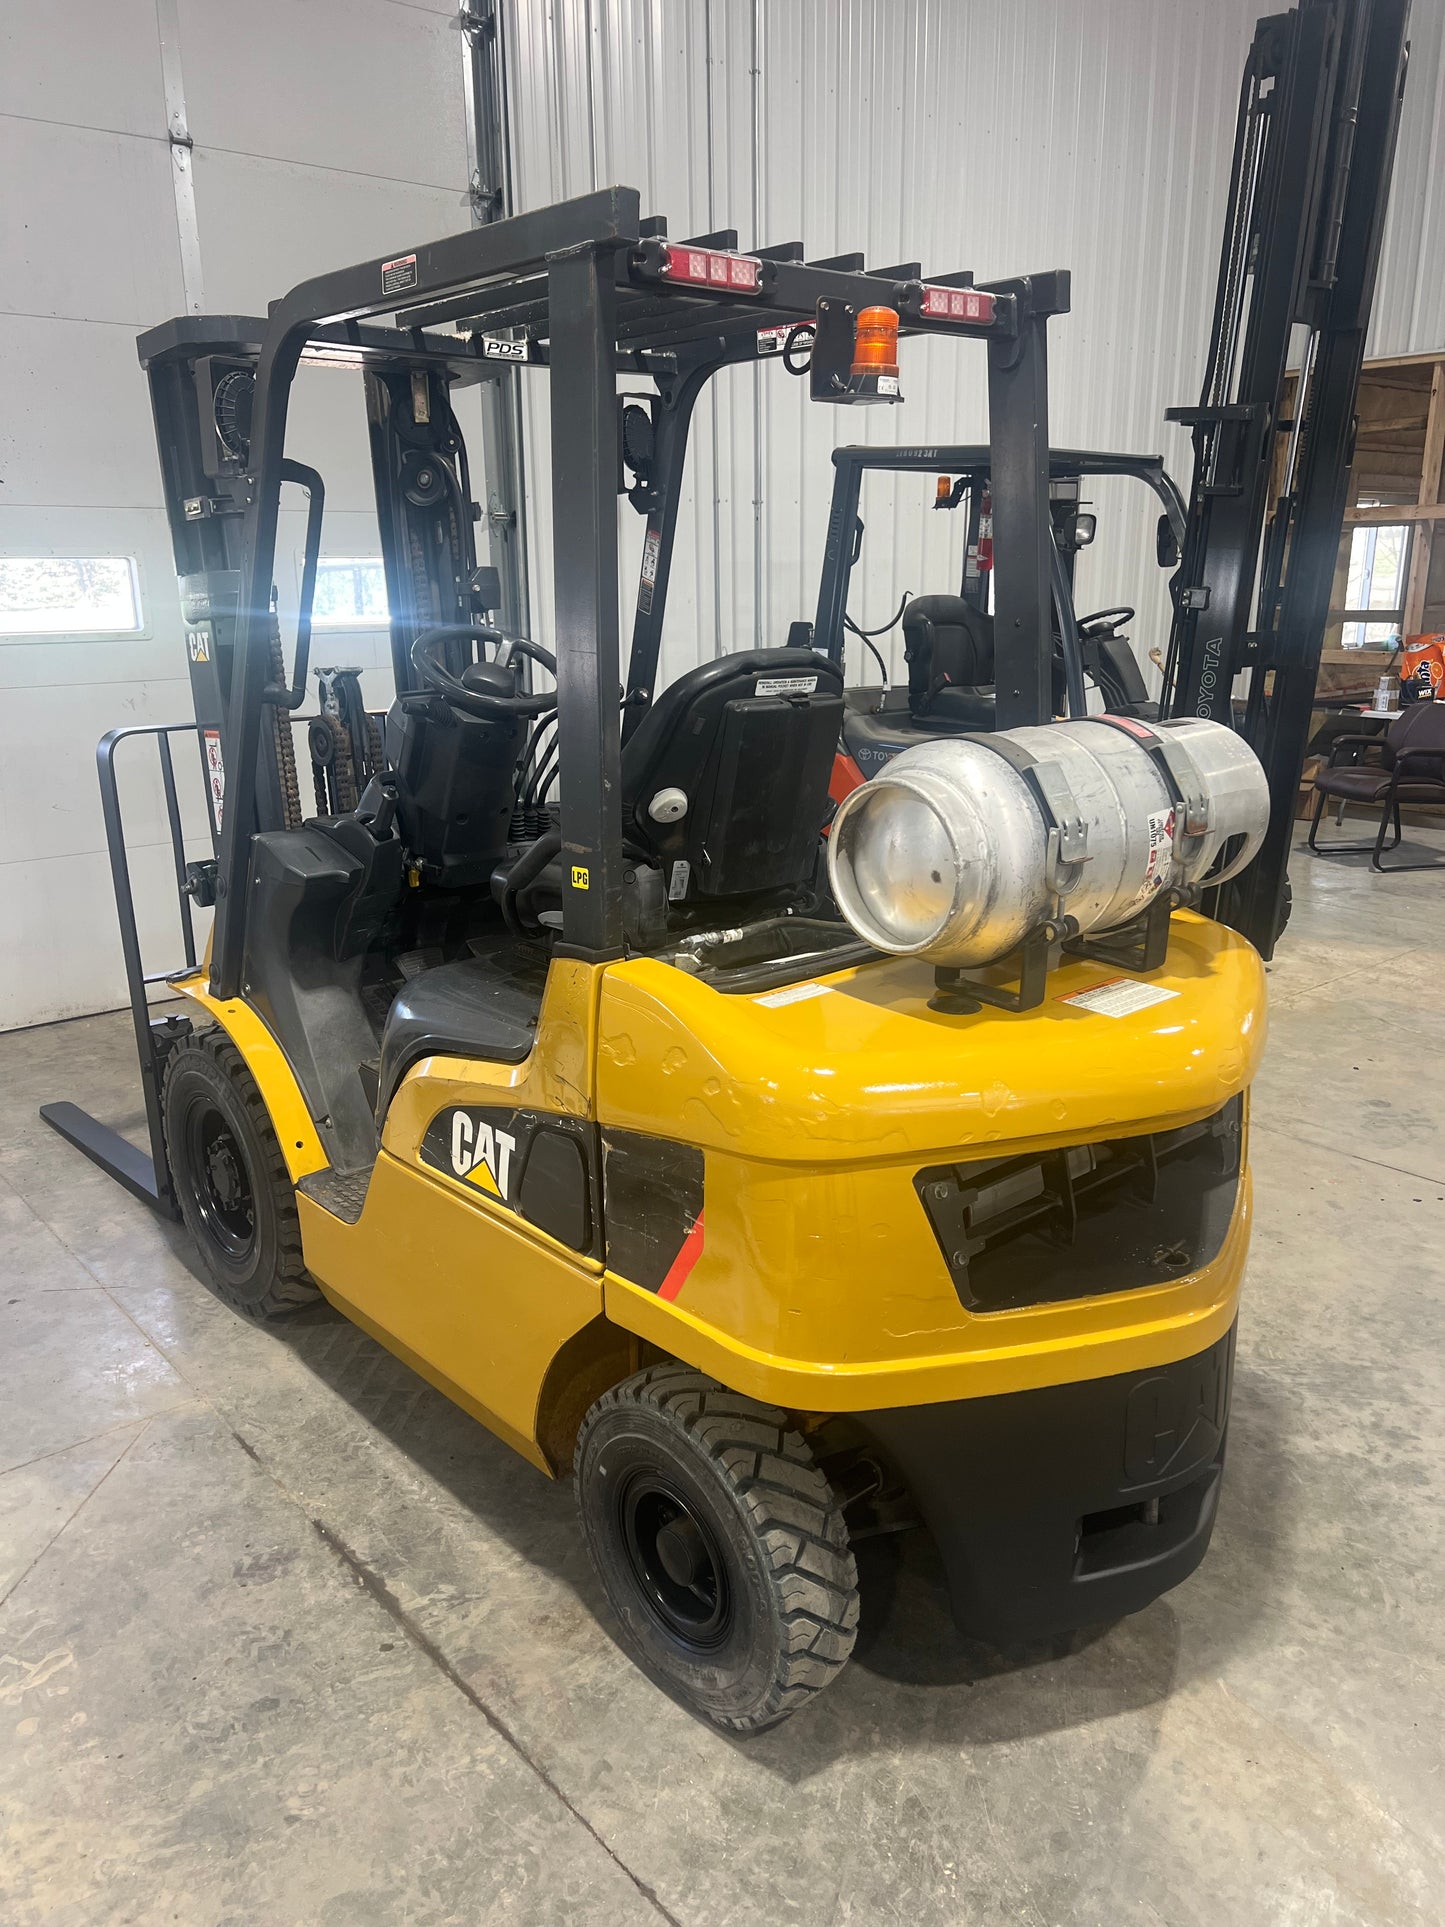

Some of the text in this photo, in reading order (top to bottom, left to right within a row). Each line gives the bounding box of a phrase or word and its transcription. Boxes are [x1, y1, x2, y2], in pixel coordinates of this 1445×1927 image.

[487, 342, 524, 355] PDS
[188, 631, 210, 662] CAT
[1196, 637, 1223, 720] OYOTA
[1418, 688, 1432, 697] WIX
[1149, 818, 1157, 848] UN1075
[572, 870, 588, 886] LPG
[452, 1111, 516, 1201] CAT
